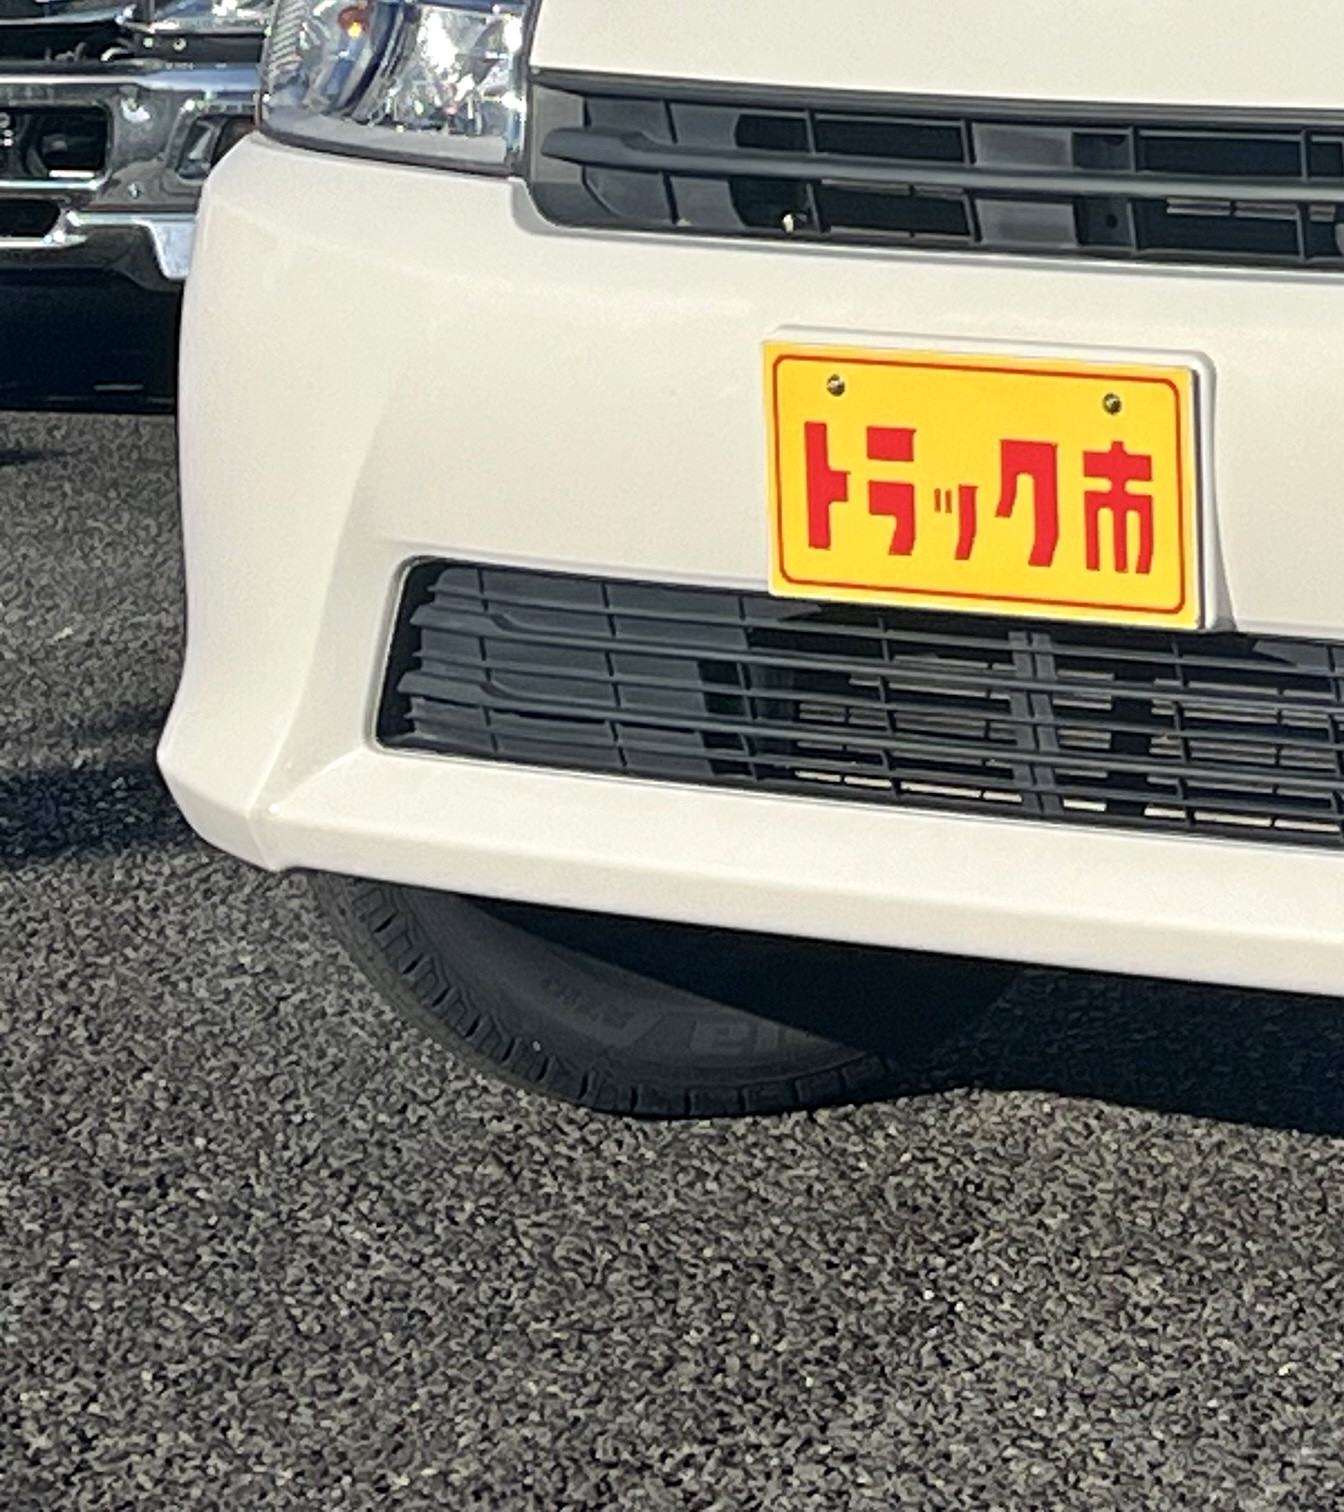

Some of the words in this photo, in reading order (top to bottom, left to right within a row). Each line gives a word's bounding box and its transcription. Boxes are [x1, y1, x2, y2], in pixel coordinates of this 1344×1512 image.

[804, 421, 1154, 575] トラック市
